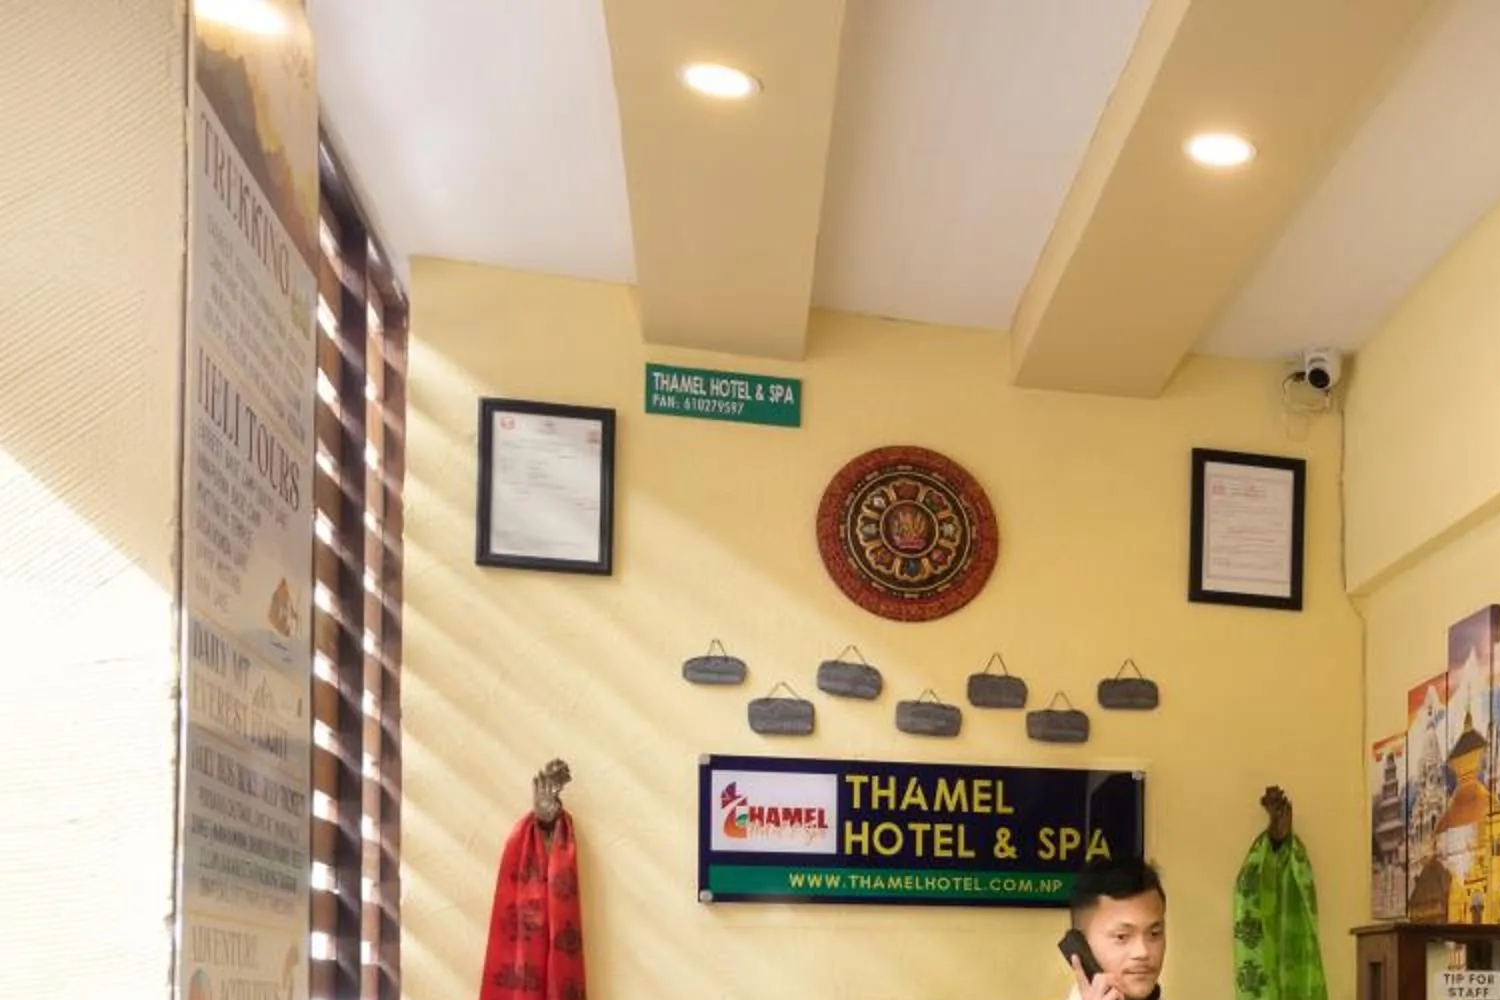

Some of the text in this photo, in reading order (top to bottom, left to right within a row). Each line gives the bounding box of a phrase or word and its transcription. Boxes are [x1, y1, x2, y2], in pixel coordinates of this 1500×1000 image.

[653, 372, 795, 405] THAMEL HOTEL & SPA
[199, 346, 240, 447] HELI
[245, 405, 299, 513] TOURS
[845, 775, 1015, 815] THAMEL
[844, 821, 976, 859] HOTEL
[993, 829, 1018, 860] &
[1038, 827, 1112, 864] SPA
[788, 872, 1063, 893] WWW.THAMELHOTEL.COM.NP
[1443, 973, 1495, 985] TIP FOR
[1448, 987, 1490, 998] STAFF
